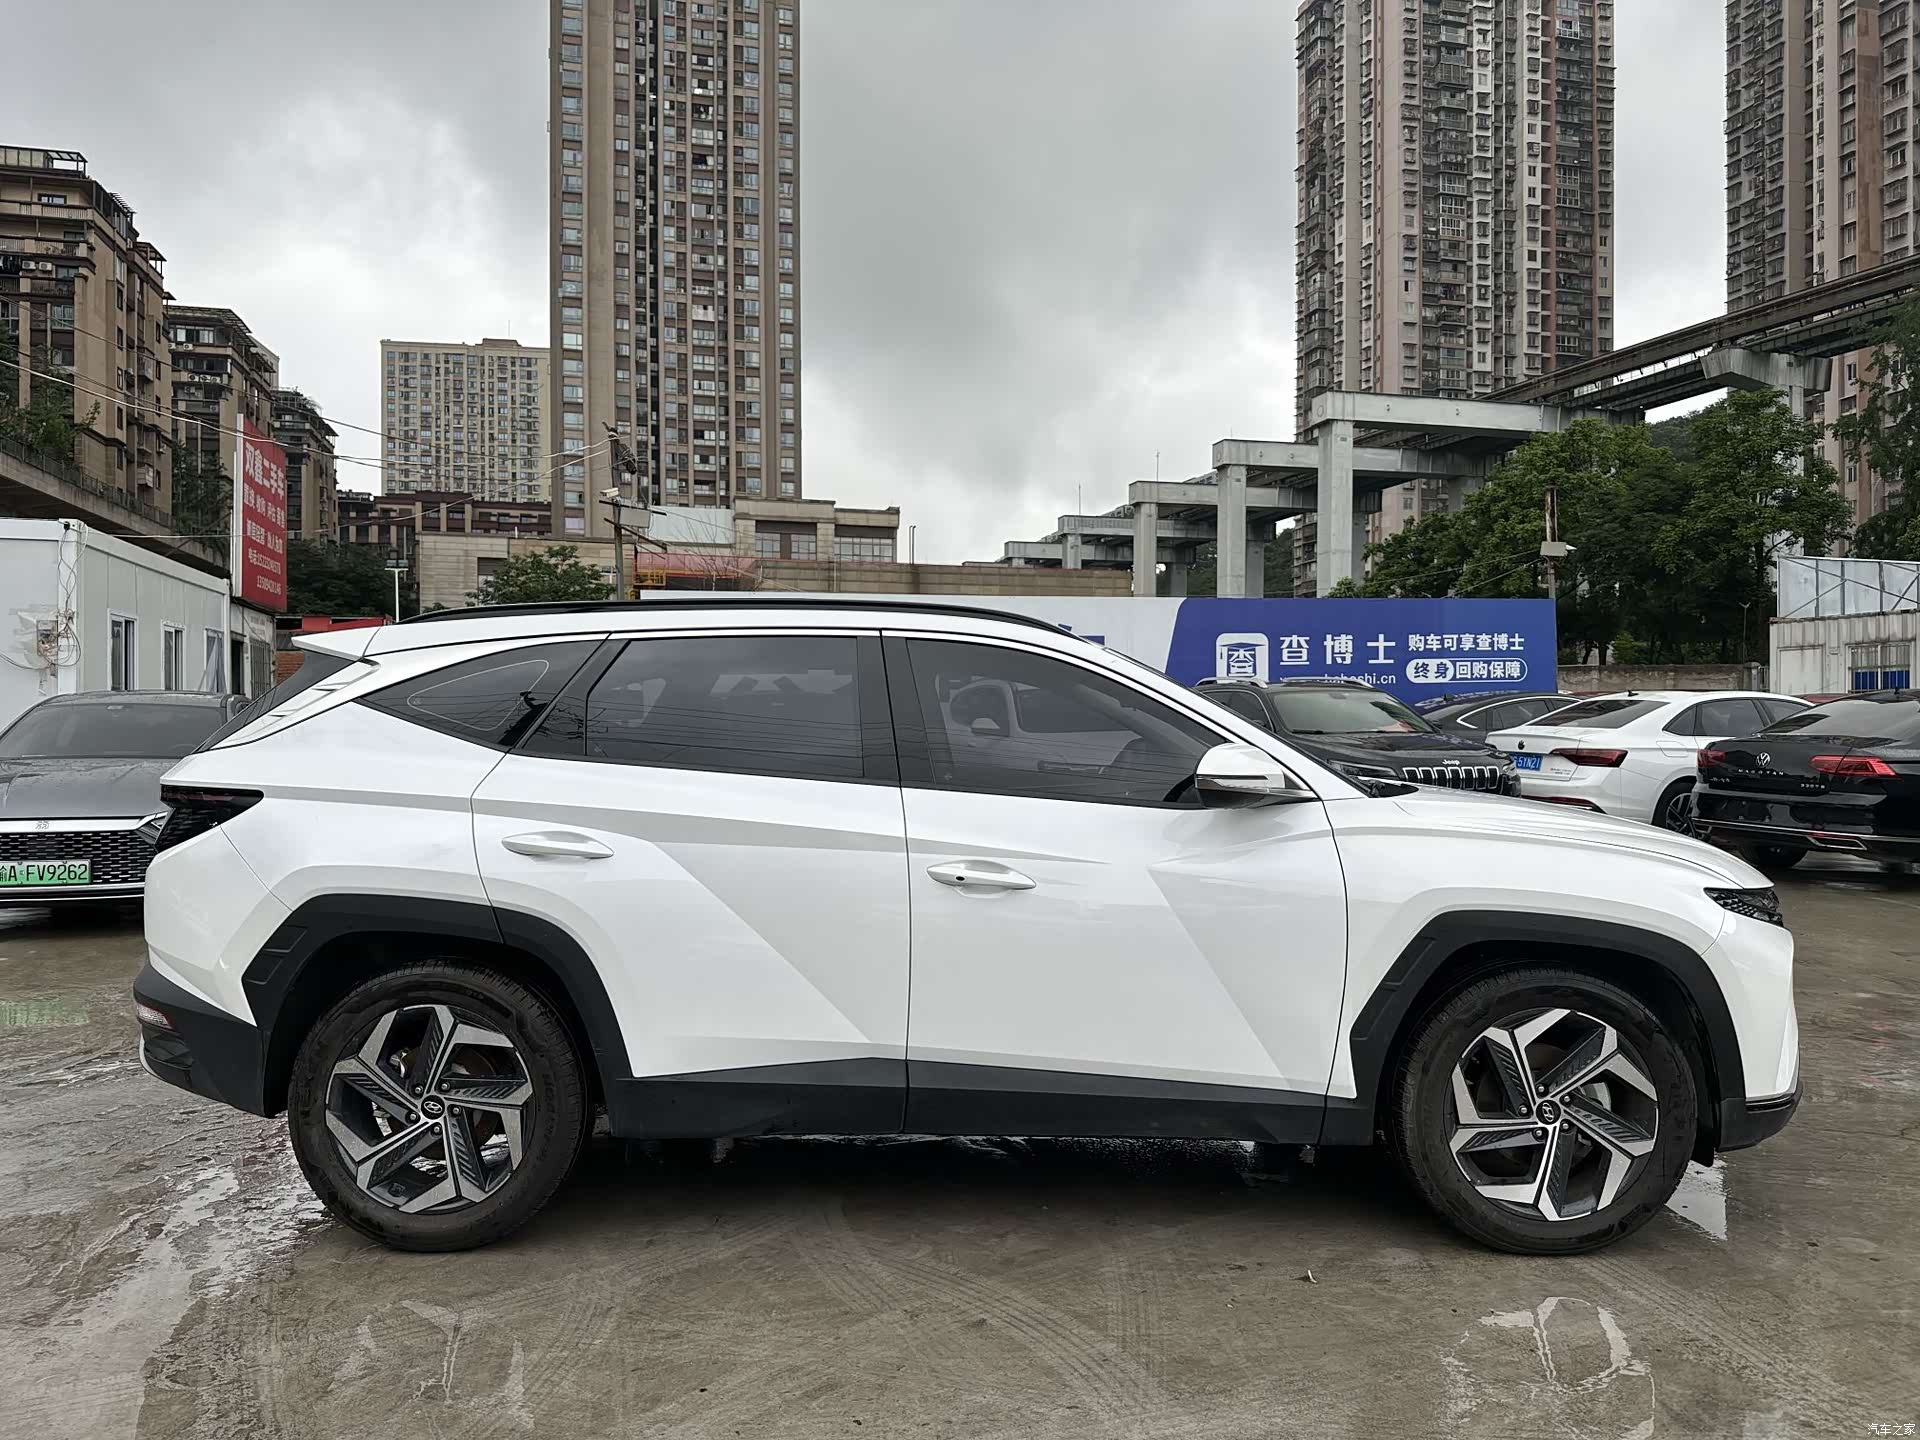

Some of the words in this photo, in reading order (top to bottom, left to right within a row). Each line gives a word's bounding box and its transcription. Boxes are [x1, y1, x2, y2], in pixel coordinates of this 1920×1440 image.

[1279, 633, 1397, 666] 查博士
[1407, 633, 1526, 652] 购车可享查博士
